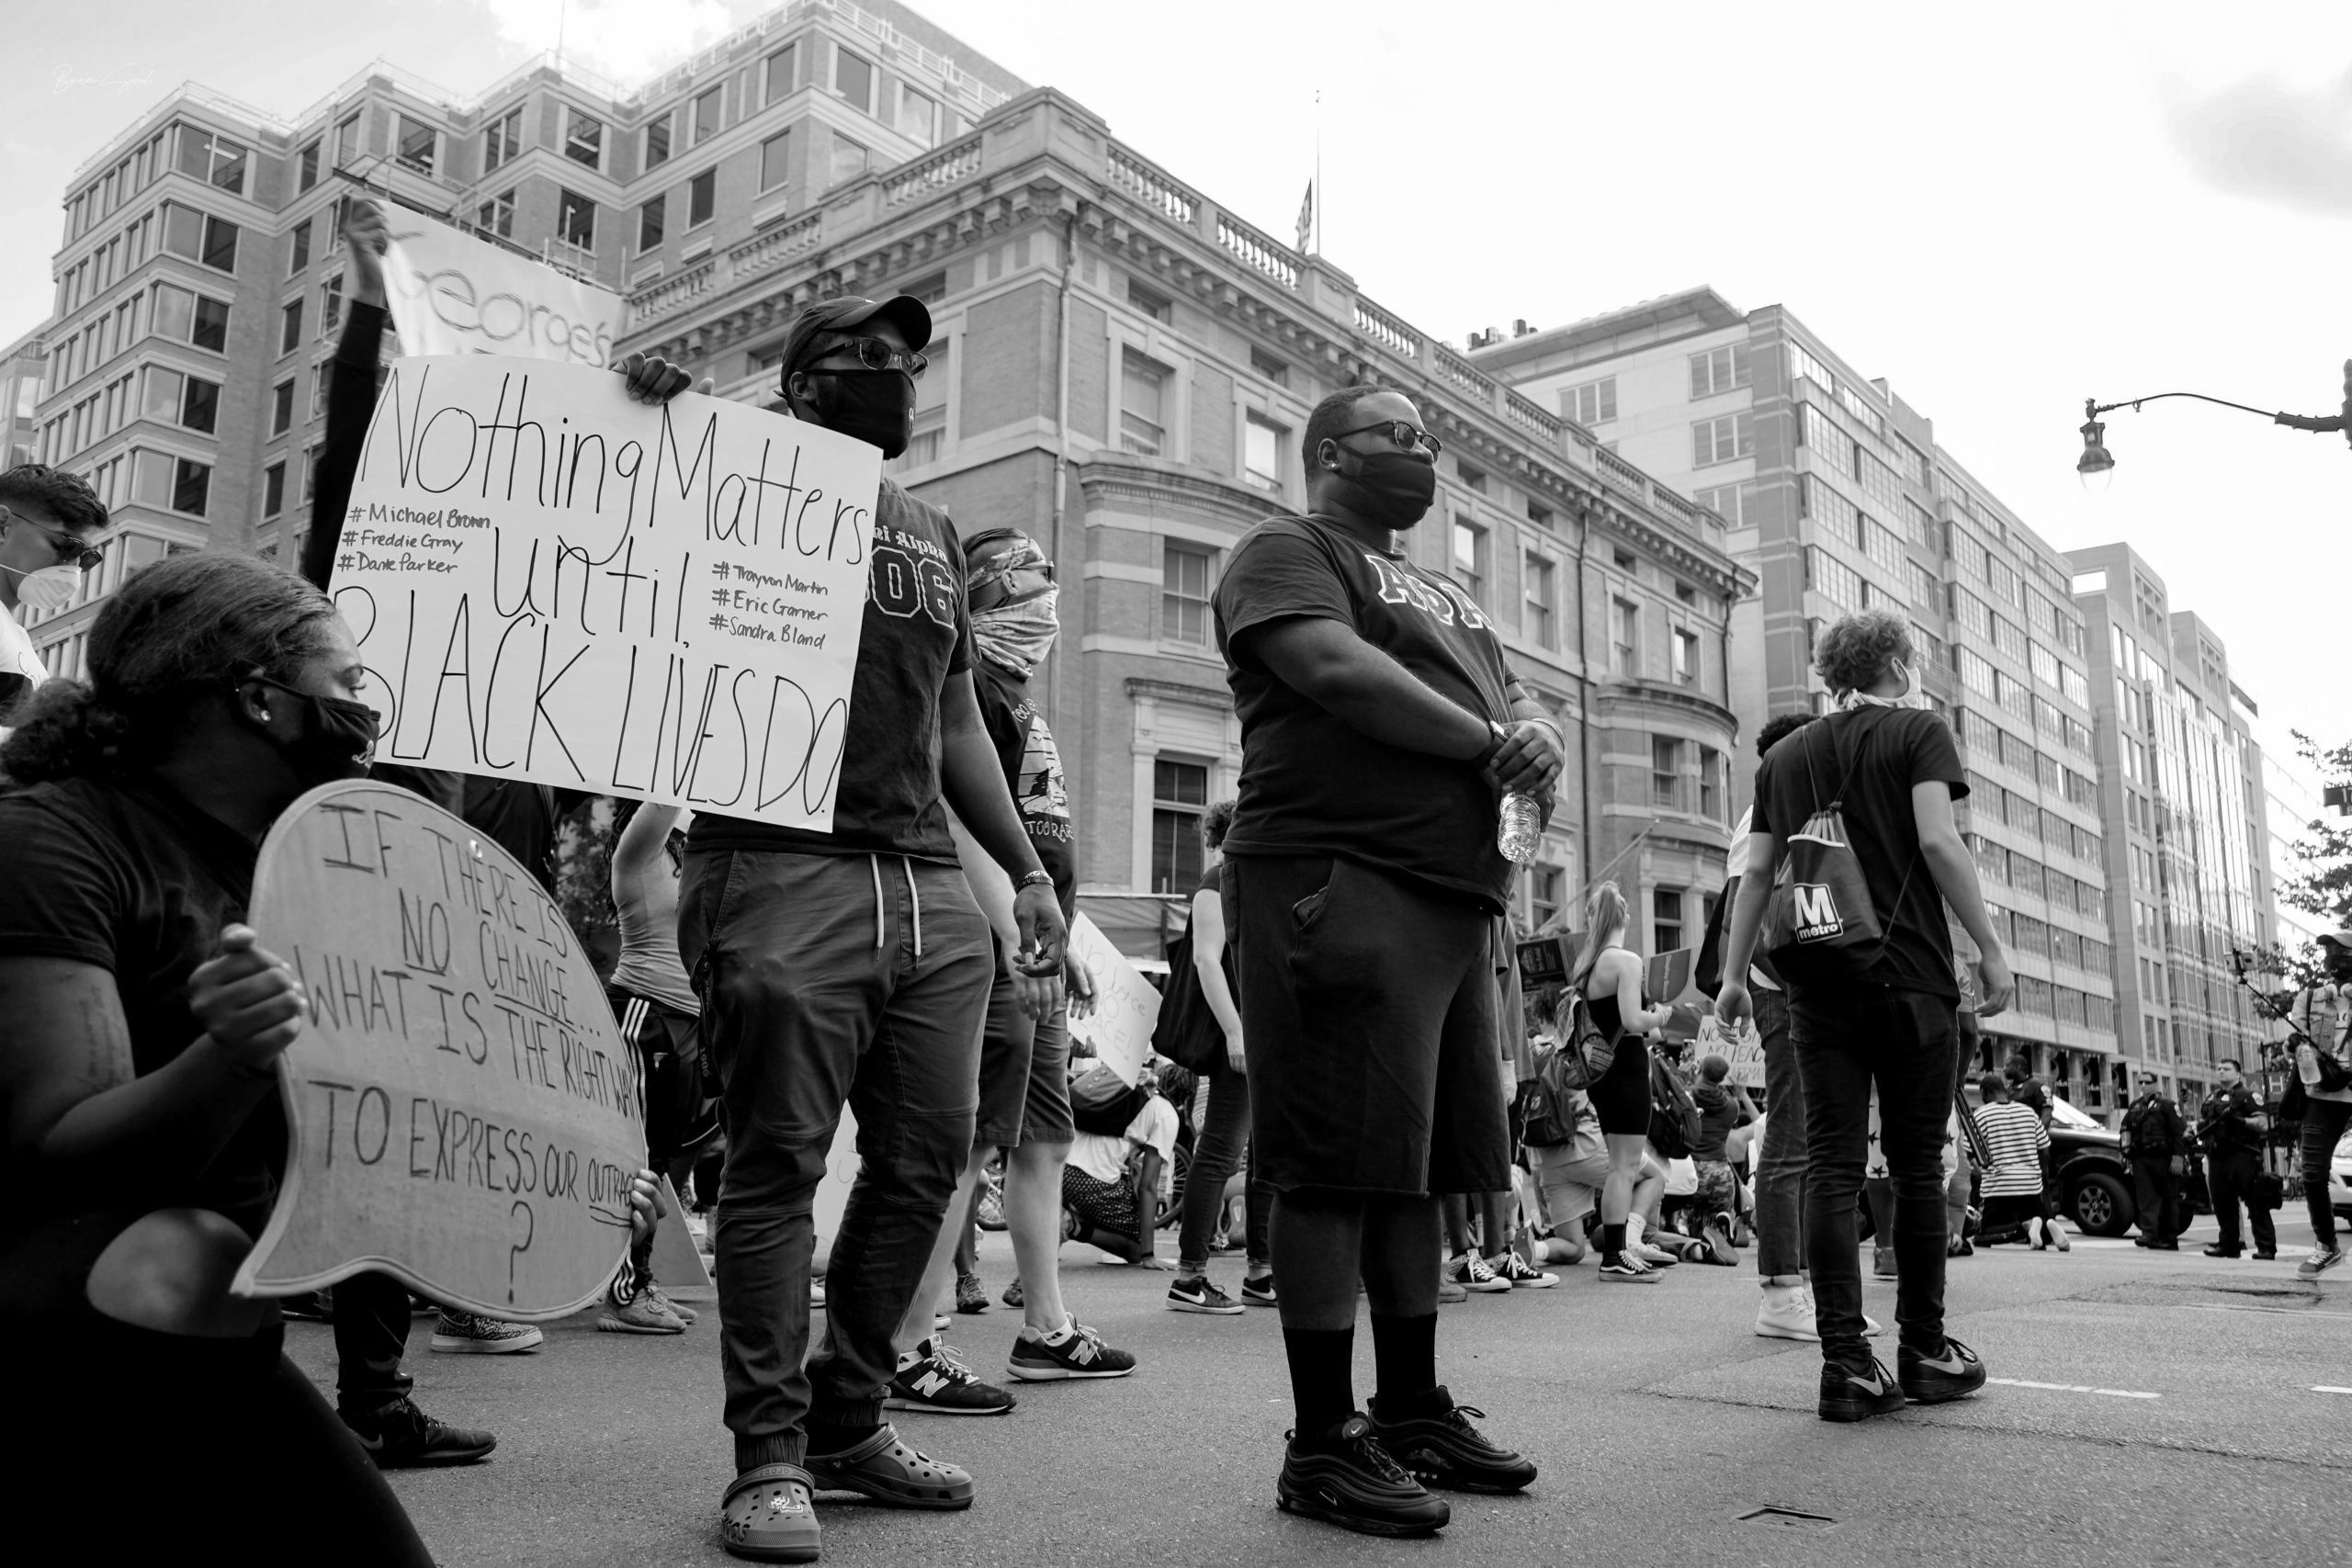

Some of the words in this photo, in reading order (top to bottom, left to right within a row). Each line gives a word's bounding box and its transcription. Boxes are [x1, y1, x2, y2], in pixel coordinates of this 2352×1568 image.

[361, 364, 644, 565] Nothing
[650, 402, 868, 565] Matters
[399, 552, 458, 573] Parker
[421, 533, 463, 554] Gray
[785, 574, 829, 596] Martin
[773, 598, 829, 621] Garner
[781, 624, 826, 650] Bland
[334, 586, 585, 783] BLACK
[612, 645, 755, 806] LIVES
[320, 802, 403, 878] IF
[422, 826, 527, 934] THERE
[528, 886, 568, 958] IS
[1793, 886, 1836, 929] M
[399, 886, 451, 973] NO
[1798, 923, 1838, 940] metro
[293, 944, 413, 1040] WHAT
[428, 984, 487, 1065] IS
[492, 1003, 556, 1090] THE
[559, 1028, 609, 1107] RIGHT
[307, 1079, 391, 1168] TO
[410, 1098, 537, 1194] EXPRESS
[544, 1144, 579, 1202] OUR
[509, 1200, 534, 1303] ?
[910, 1370, 950, 1398] N
